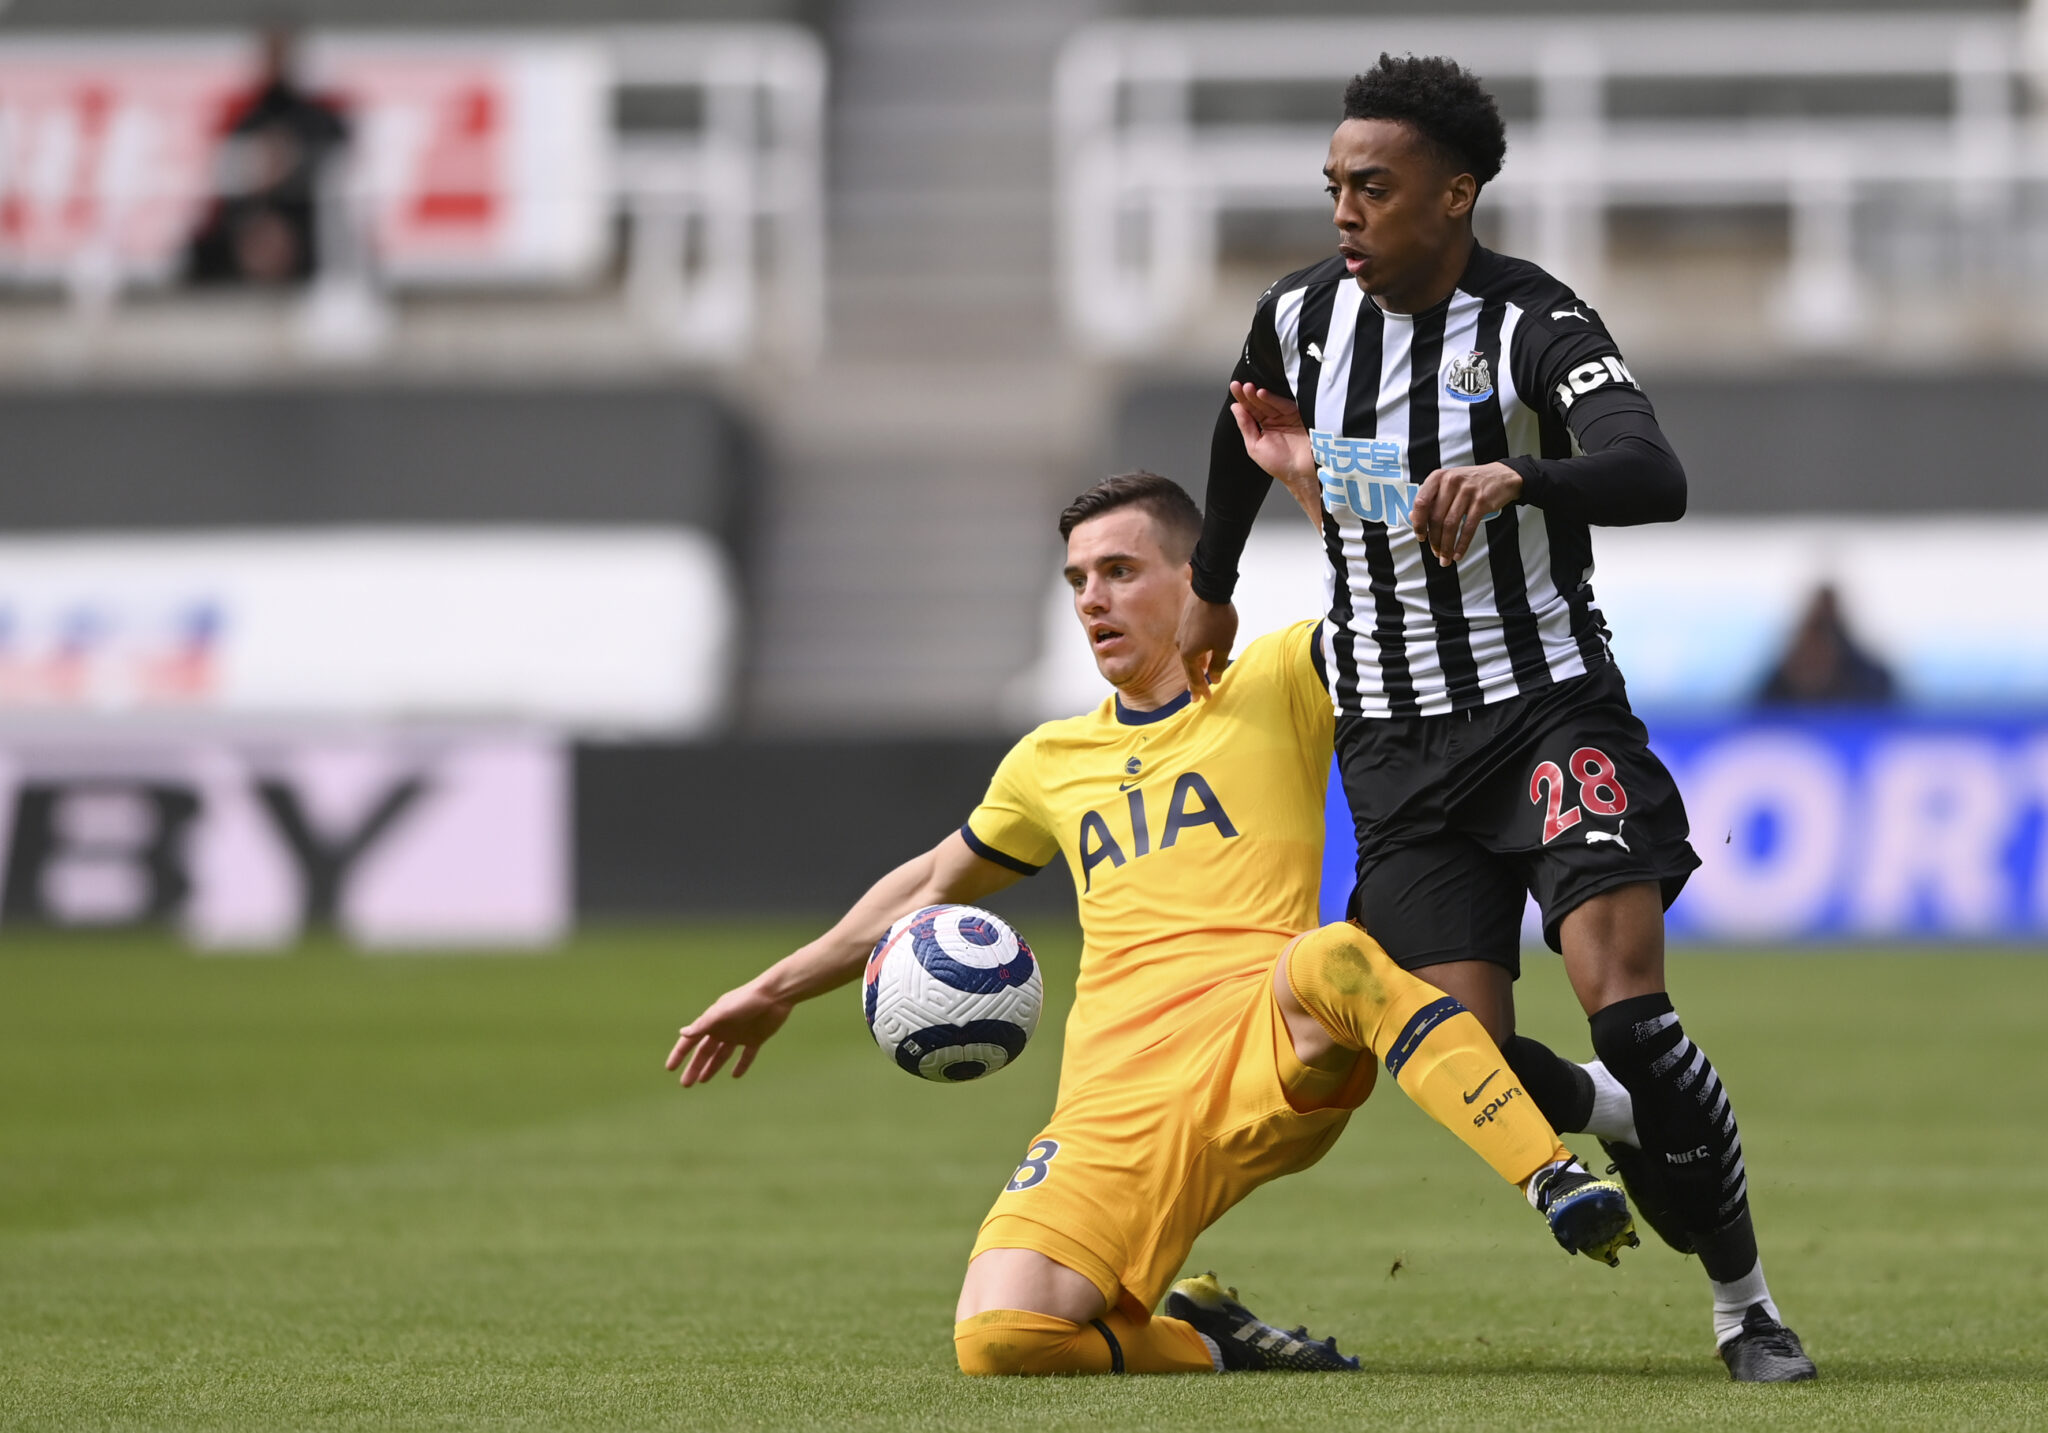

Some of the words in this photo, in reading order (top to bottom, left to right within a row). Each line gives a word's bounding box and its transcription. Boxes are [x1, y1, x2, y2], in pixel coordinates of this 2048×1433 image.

[1311, 430, 1402, 479] 乐天堂
[1317, 470, 1501, 528] FUN
[1529, 746, 1628, 845] 28
[1079, 771, 1239, 895] AIA
[1473, 1087, 1522, 1128] spurs
[1665, 1144, 1711, 1164] NUFC
